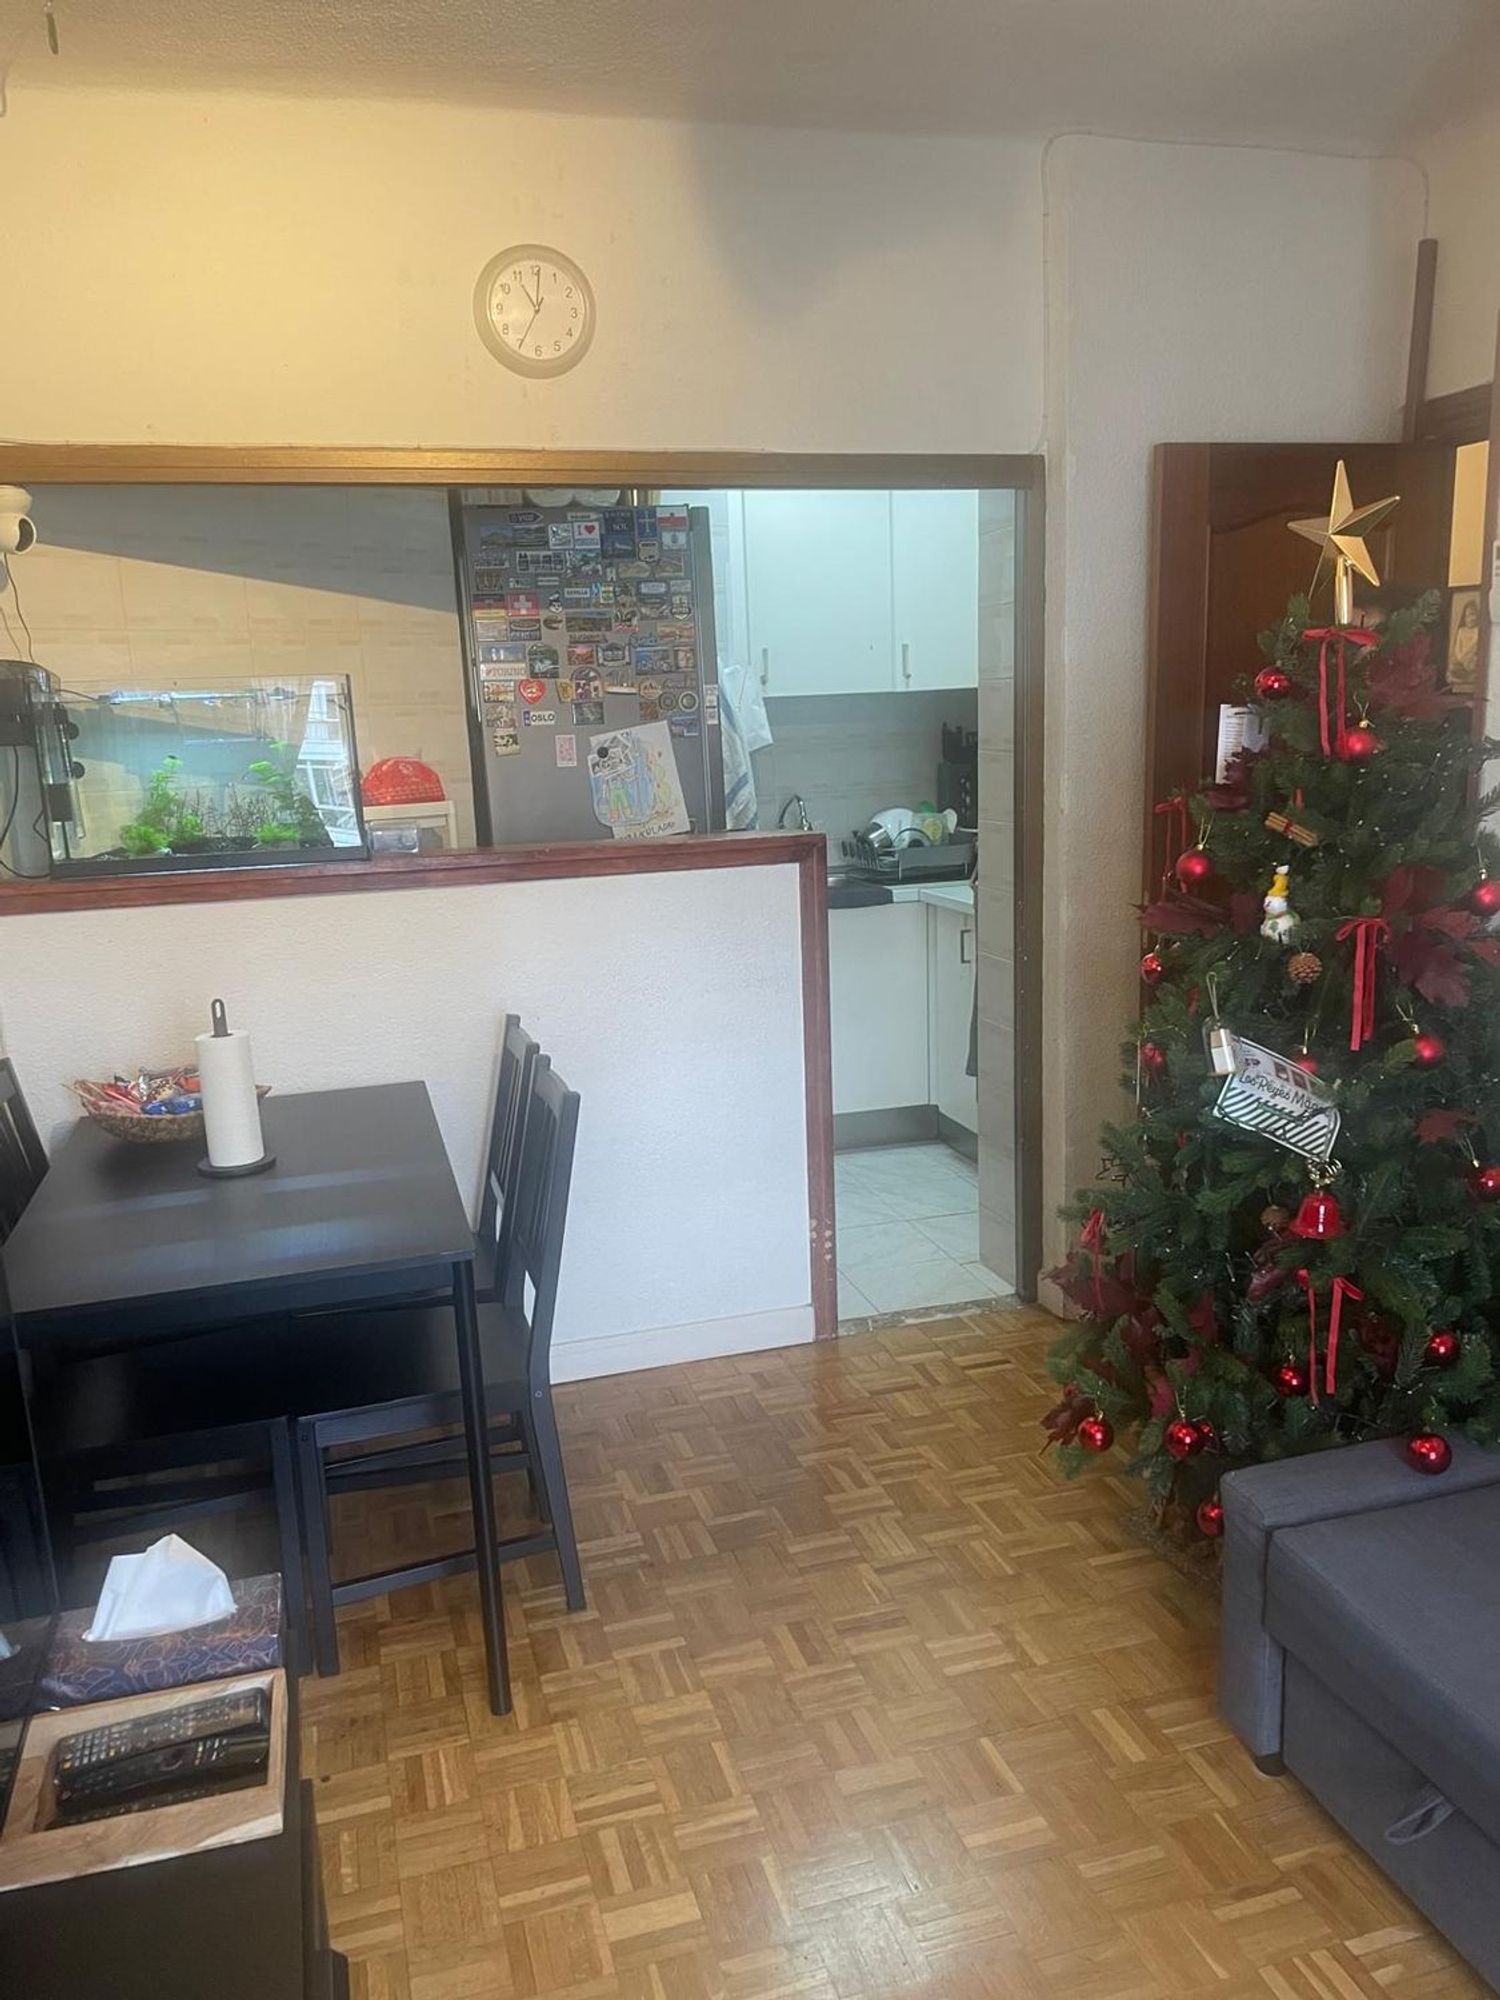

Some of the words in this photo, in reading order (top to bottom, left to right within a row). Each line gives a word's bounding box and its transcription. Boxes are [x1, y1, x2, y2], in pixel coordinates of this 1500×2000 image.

[513, 270, 523, 282] 11
[530, 264, 541, 276] 12
[500, 282, 511, 295] 10
[565, 286, 574, 298] 2
[496, 303, 503, 315] 9
[570, 307, 578, 319] 3
[502, 323, 509, 335] 8
[566, 327, 573, 338] 4
[534, 345, 543, 357] 6
[553, 340, 561, 352] 5
[531, 713, 555, 723] OSLO
[1239, 1068, 1256, 1085] Los
[1255, 1075, 1291, 1099] Reyes
